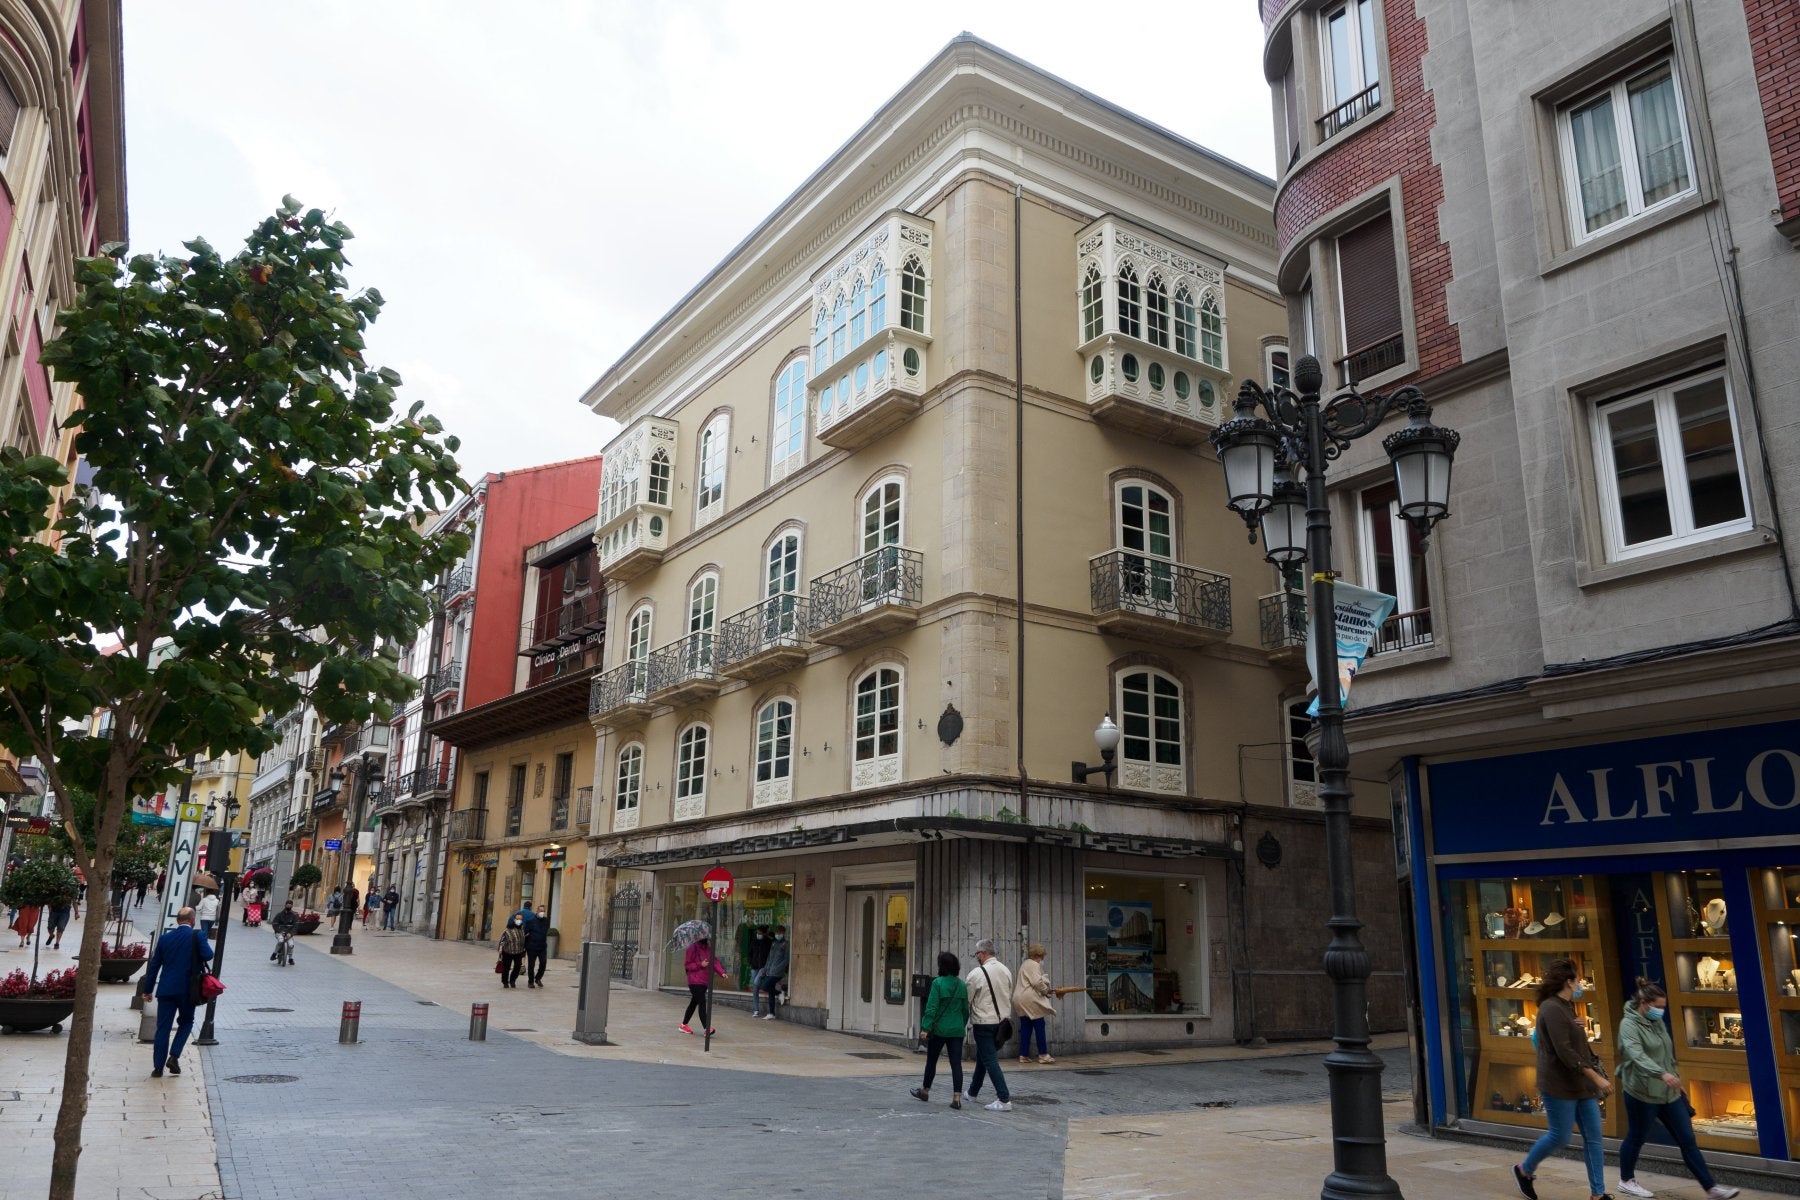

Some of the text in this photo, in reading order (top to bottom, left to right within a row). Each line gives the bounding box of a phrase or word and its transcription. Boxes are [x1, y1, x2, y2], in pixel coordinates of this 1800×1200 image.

[1334, 613, 1375, 628] stamos
[1336, 624, 1373, 636] staremos
[559, 640, 581, 658] Dental
[1540, 749, 1800, 825] ALFLO
[164, 839, 192, 934] AVIL
